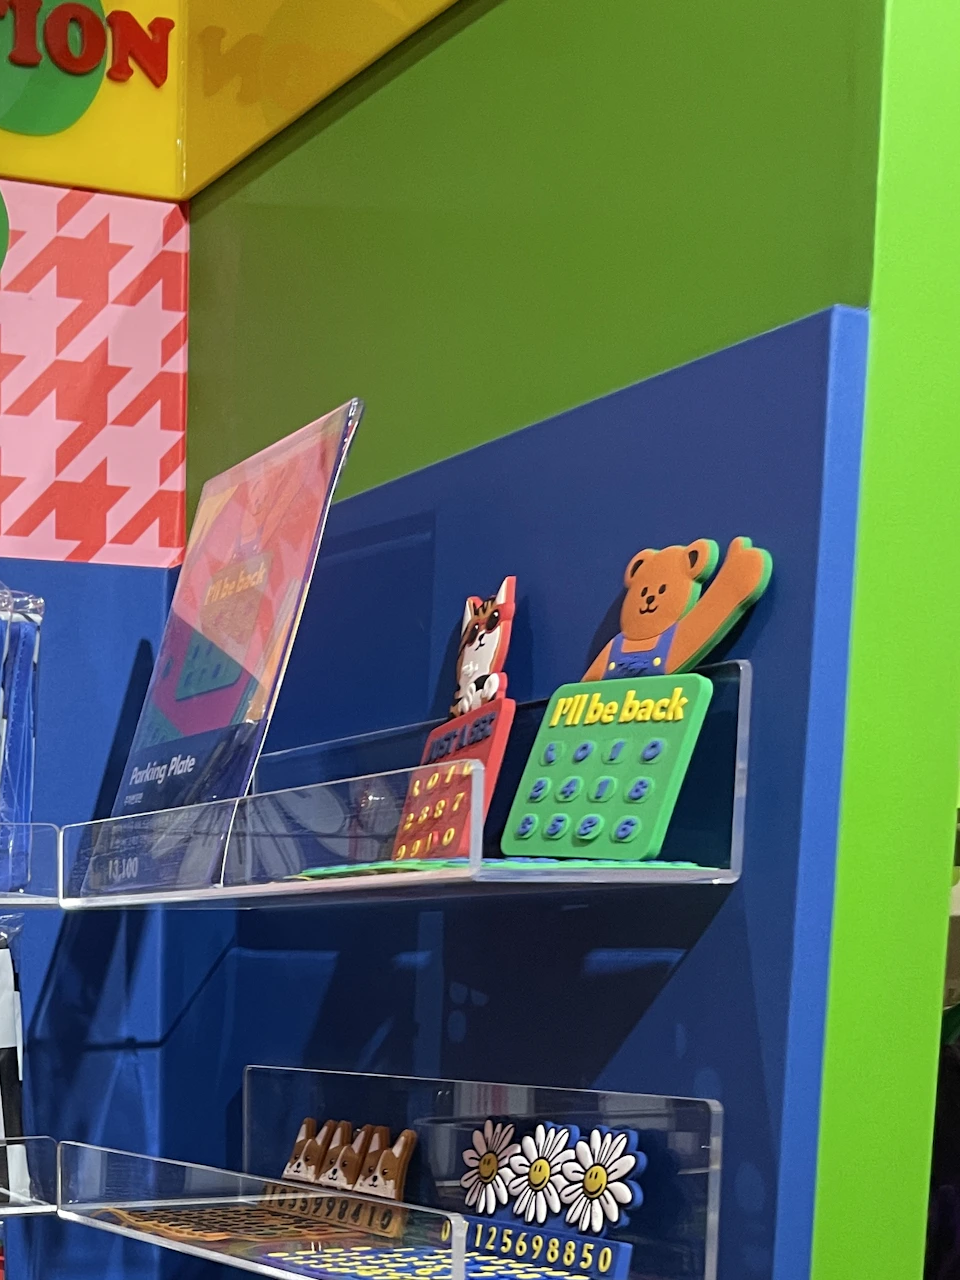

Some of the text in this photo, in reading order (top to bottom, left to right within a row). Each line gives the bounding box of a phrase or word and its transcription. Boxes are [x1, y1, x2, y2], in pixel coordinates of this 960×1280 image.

[220, 576, 237, 599] be
[549, 687, 688, 728] I'll be back
[129, 755, 196, 785] Parking Plate
